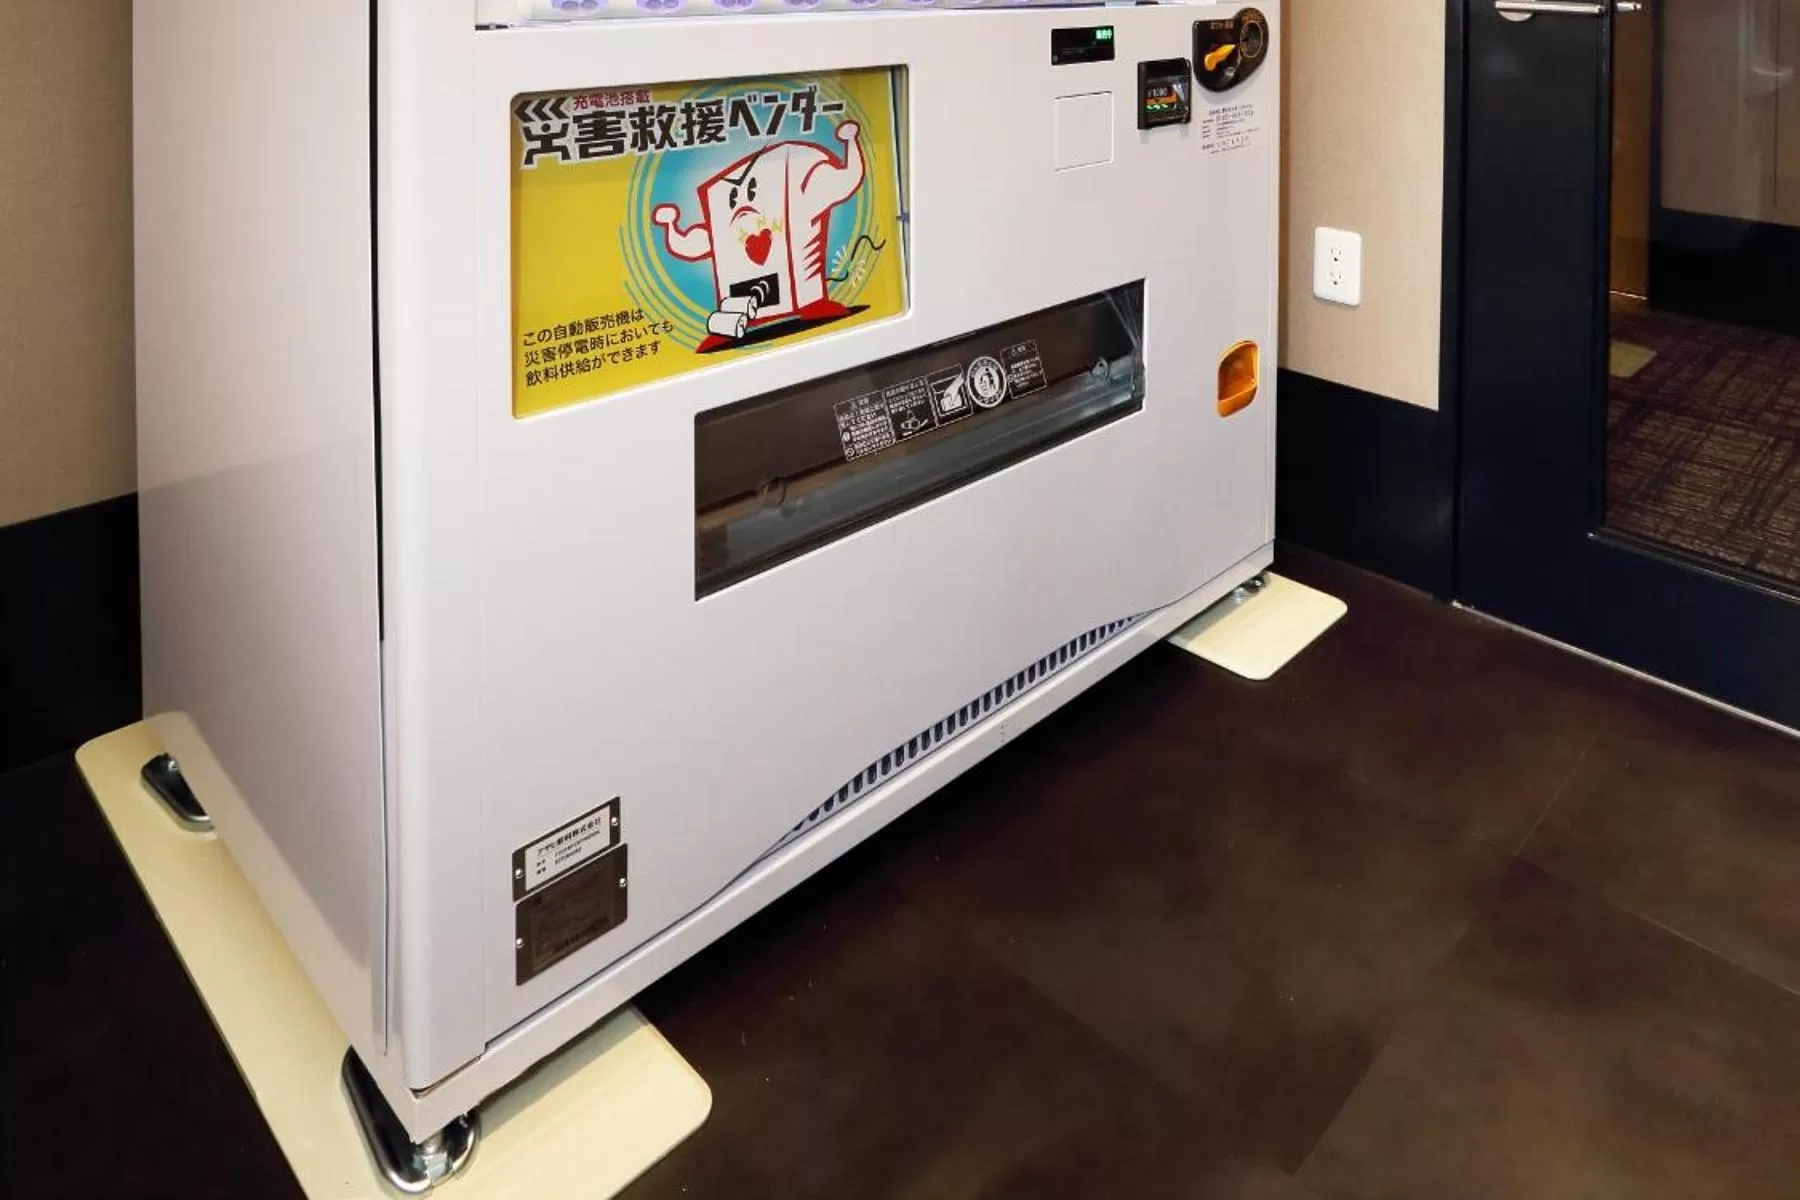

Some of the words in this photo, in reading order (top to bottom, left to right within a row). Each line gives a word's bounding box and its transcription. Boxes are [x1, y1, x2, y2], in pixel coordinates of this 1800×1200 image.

[573, 89, 651, 110] 充電池搭載
[514, 84, 844, 165] 災害救援ベンダー
[523, 308, 645, 347] この自動販売機は
[525, 320, 673, 367] 災害停電時においても
[526, 340, 661, 387] 飲料供給ができます
